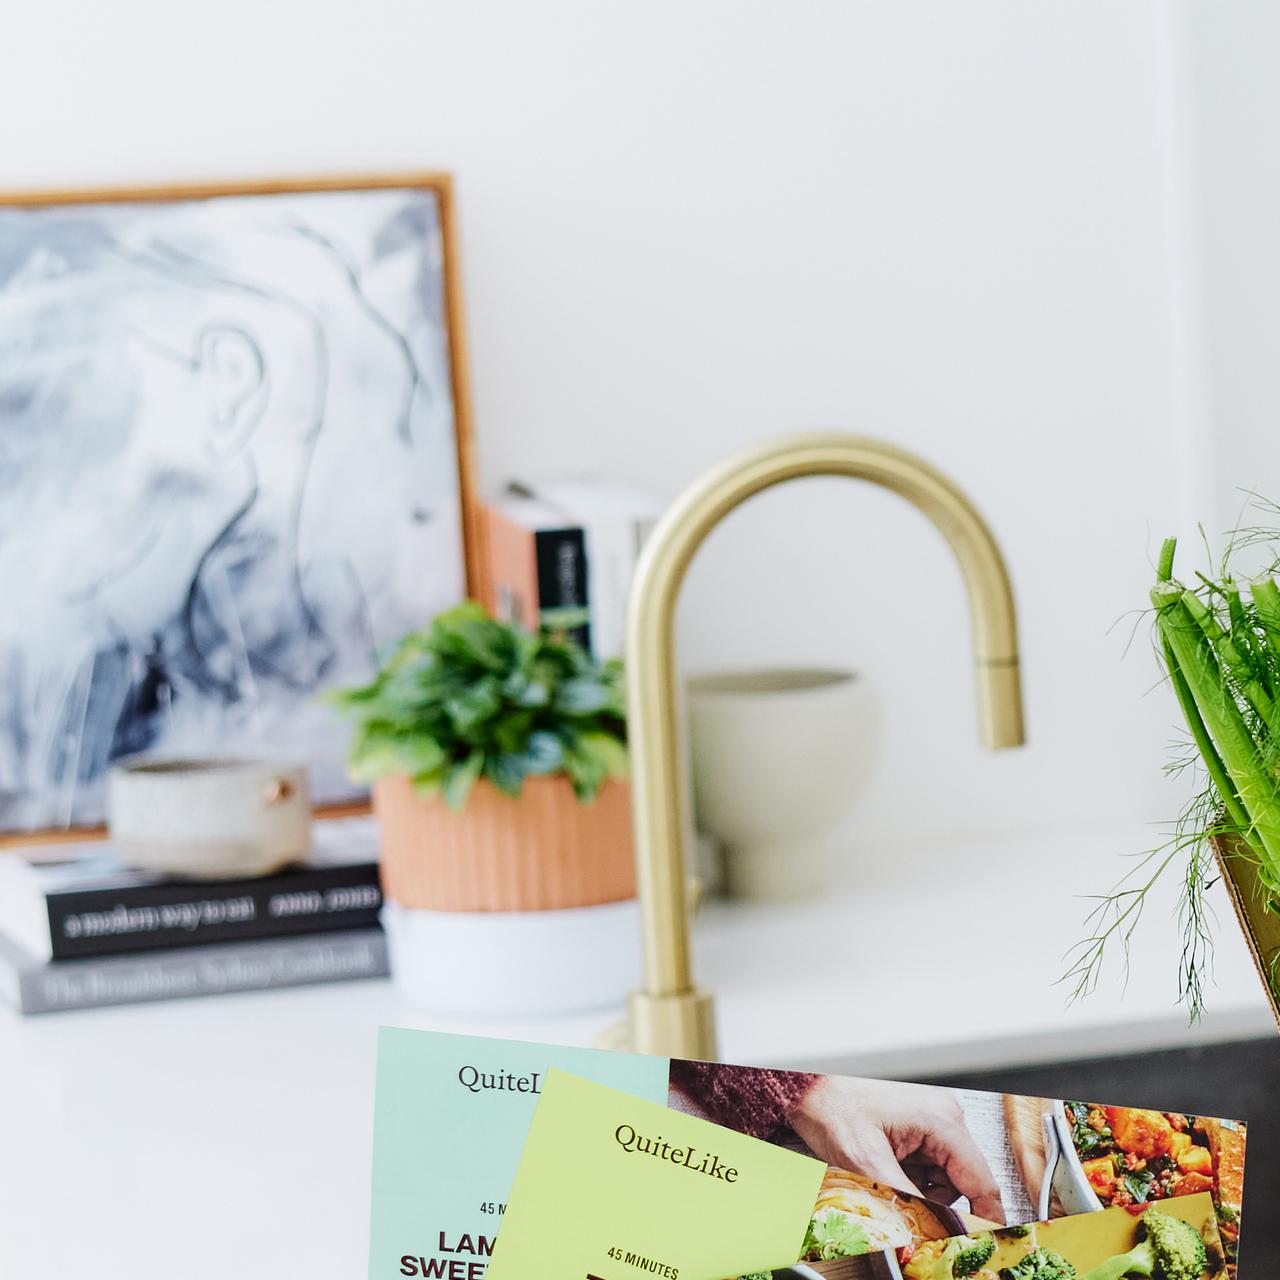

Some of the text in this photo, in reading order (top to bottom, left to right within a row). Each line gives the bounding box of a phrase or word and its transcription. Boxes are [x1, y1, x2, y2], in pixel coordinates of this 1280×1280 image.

[458, 1065, 541, 1094] QuiteL
[615, 1124, 739, 1183] QuiteLike
[480, 1202, 495, 1215] 45
[438, 1231, 497, 1257] LAM
[607, 1246, 679, 1280] 45 MINUTES
